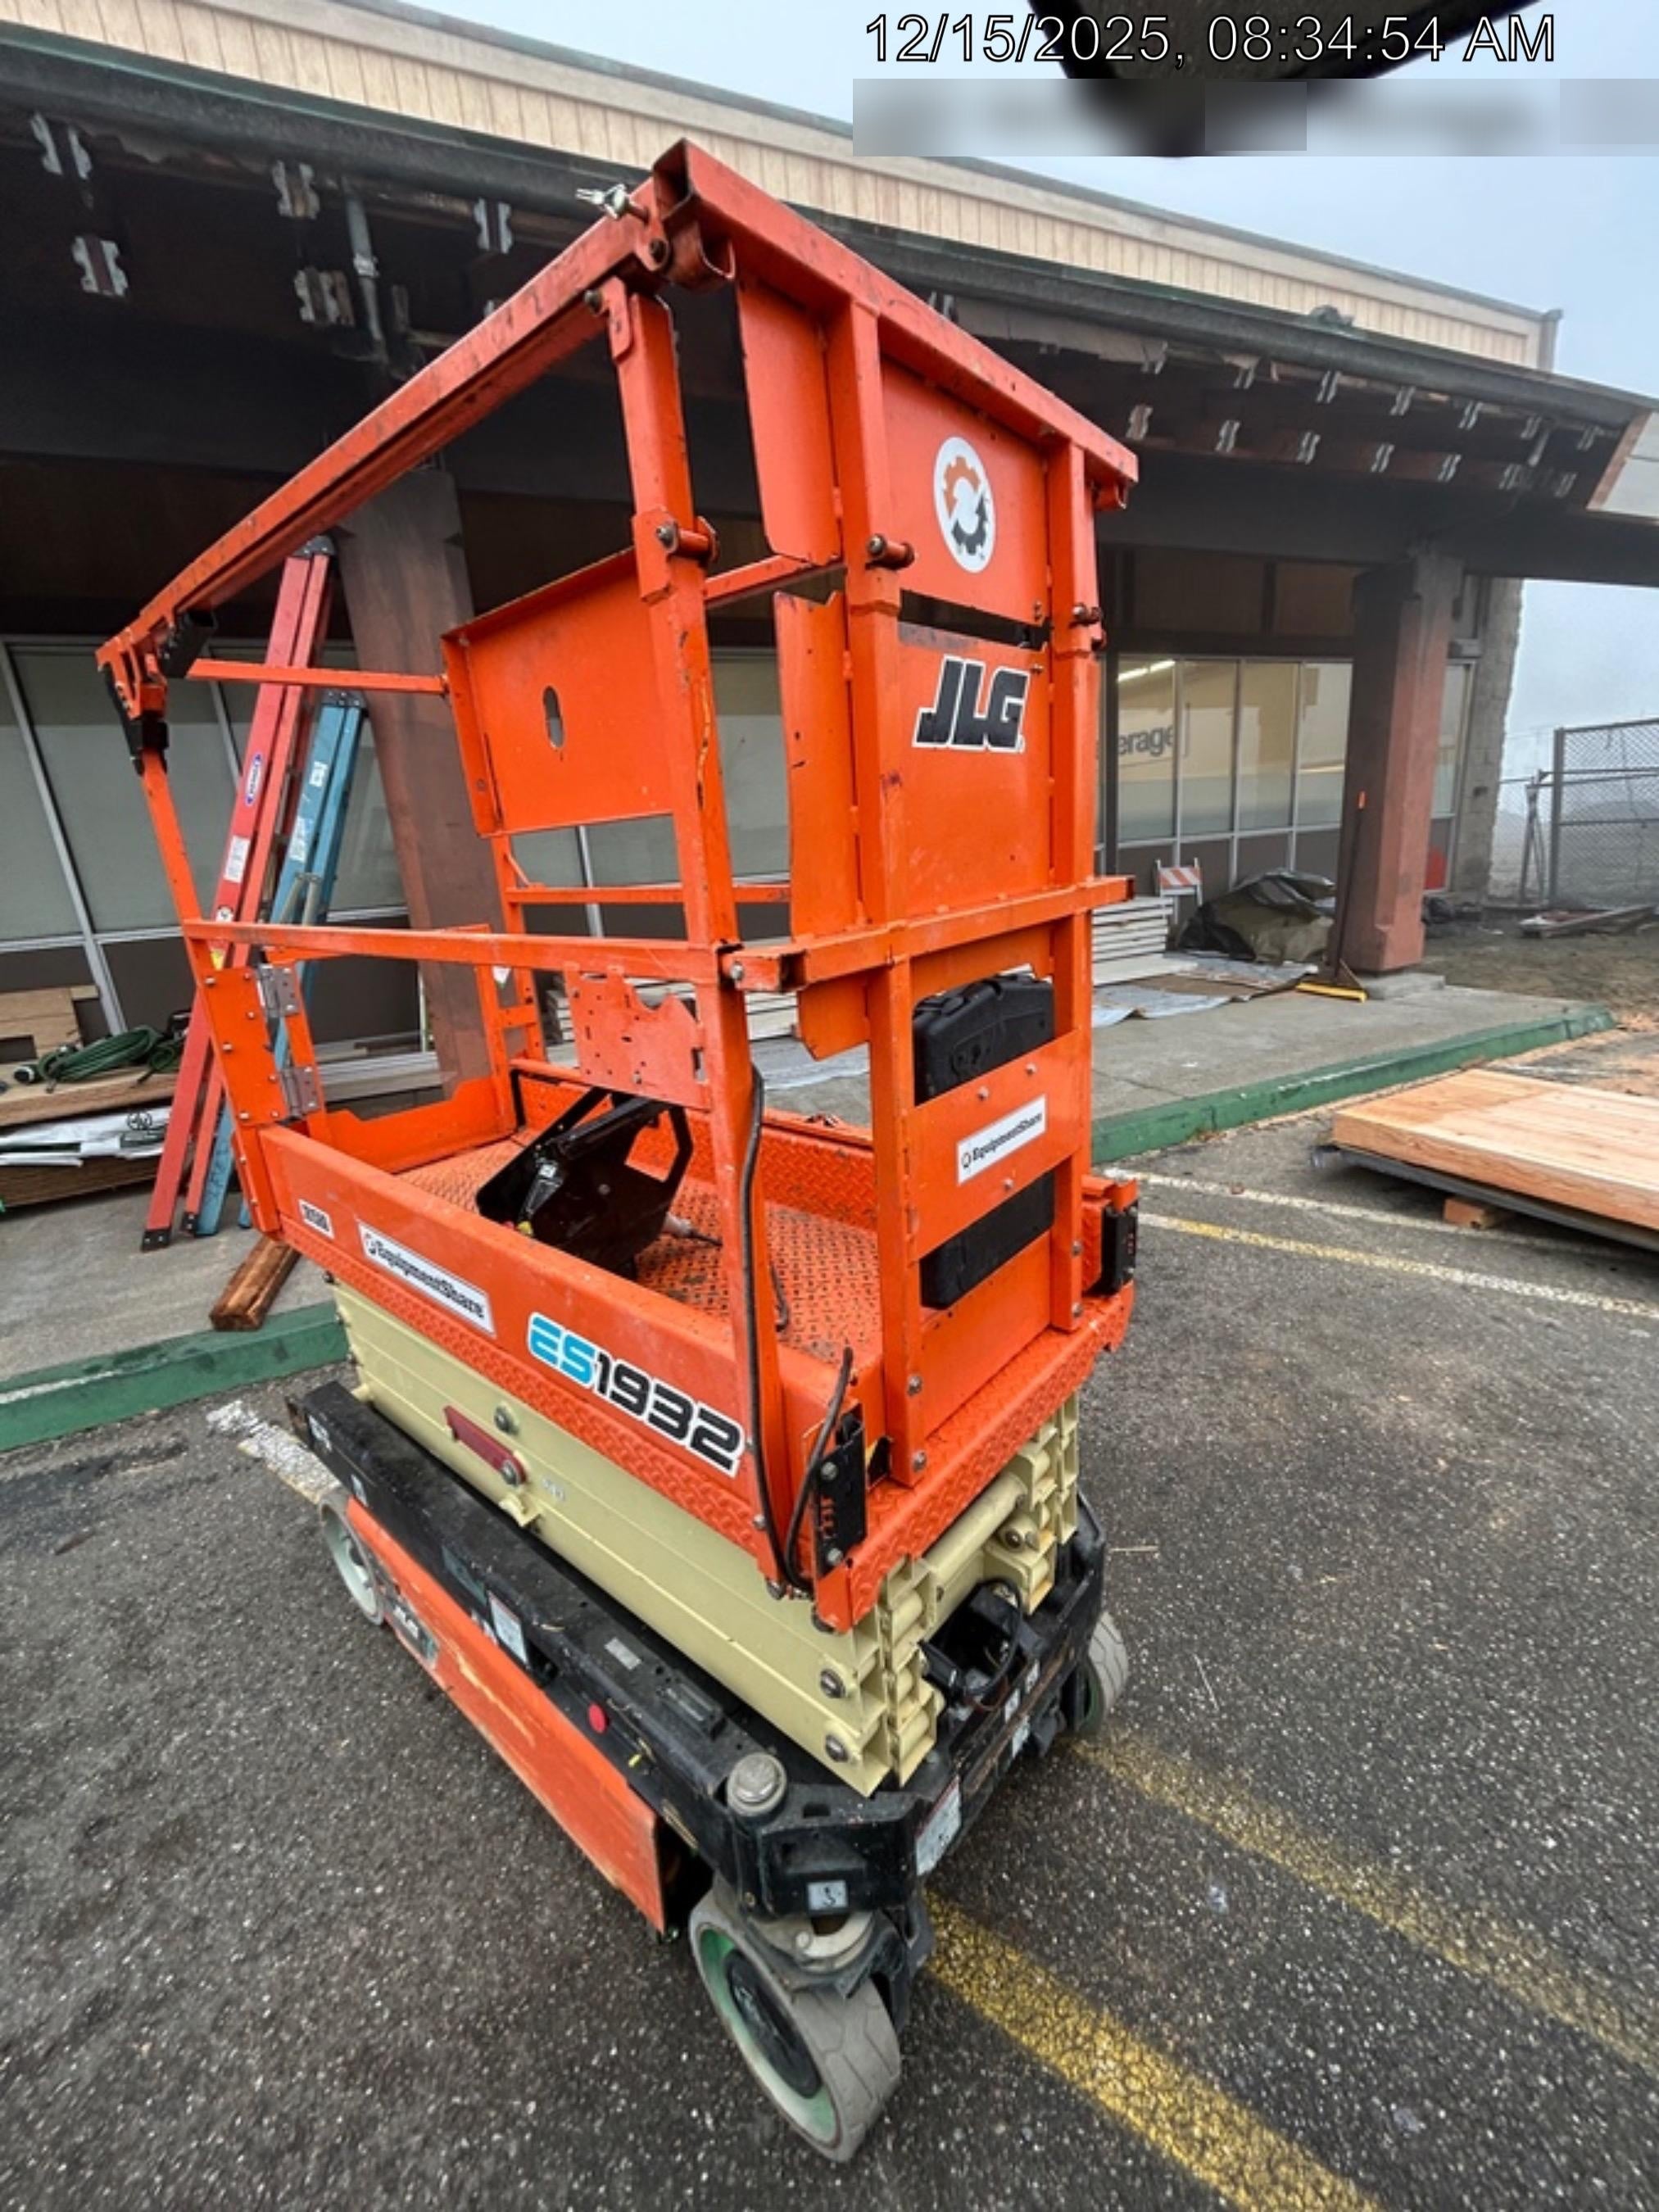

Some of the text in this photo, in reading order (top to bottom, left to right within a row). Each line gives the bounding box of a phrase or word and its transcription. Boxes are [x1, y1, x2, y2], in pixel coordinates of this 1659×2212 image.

[912, 655, 1029, 753] JLG
[374, 1239, 485, 1319] EquipmentShare
[528, 1312, 744, 1476] ES1932
